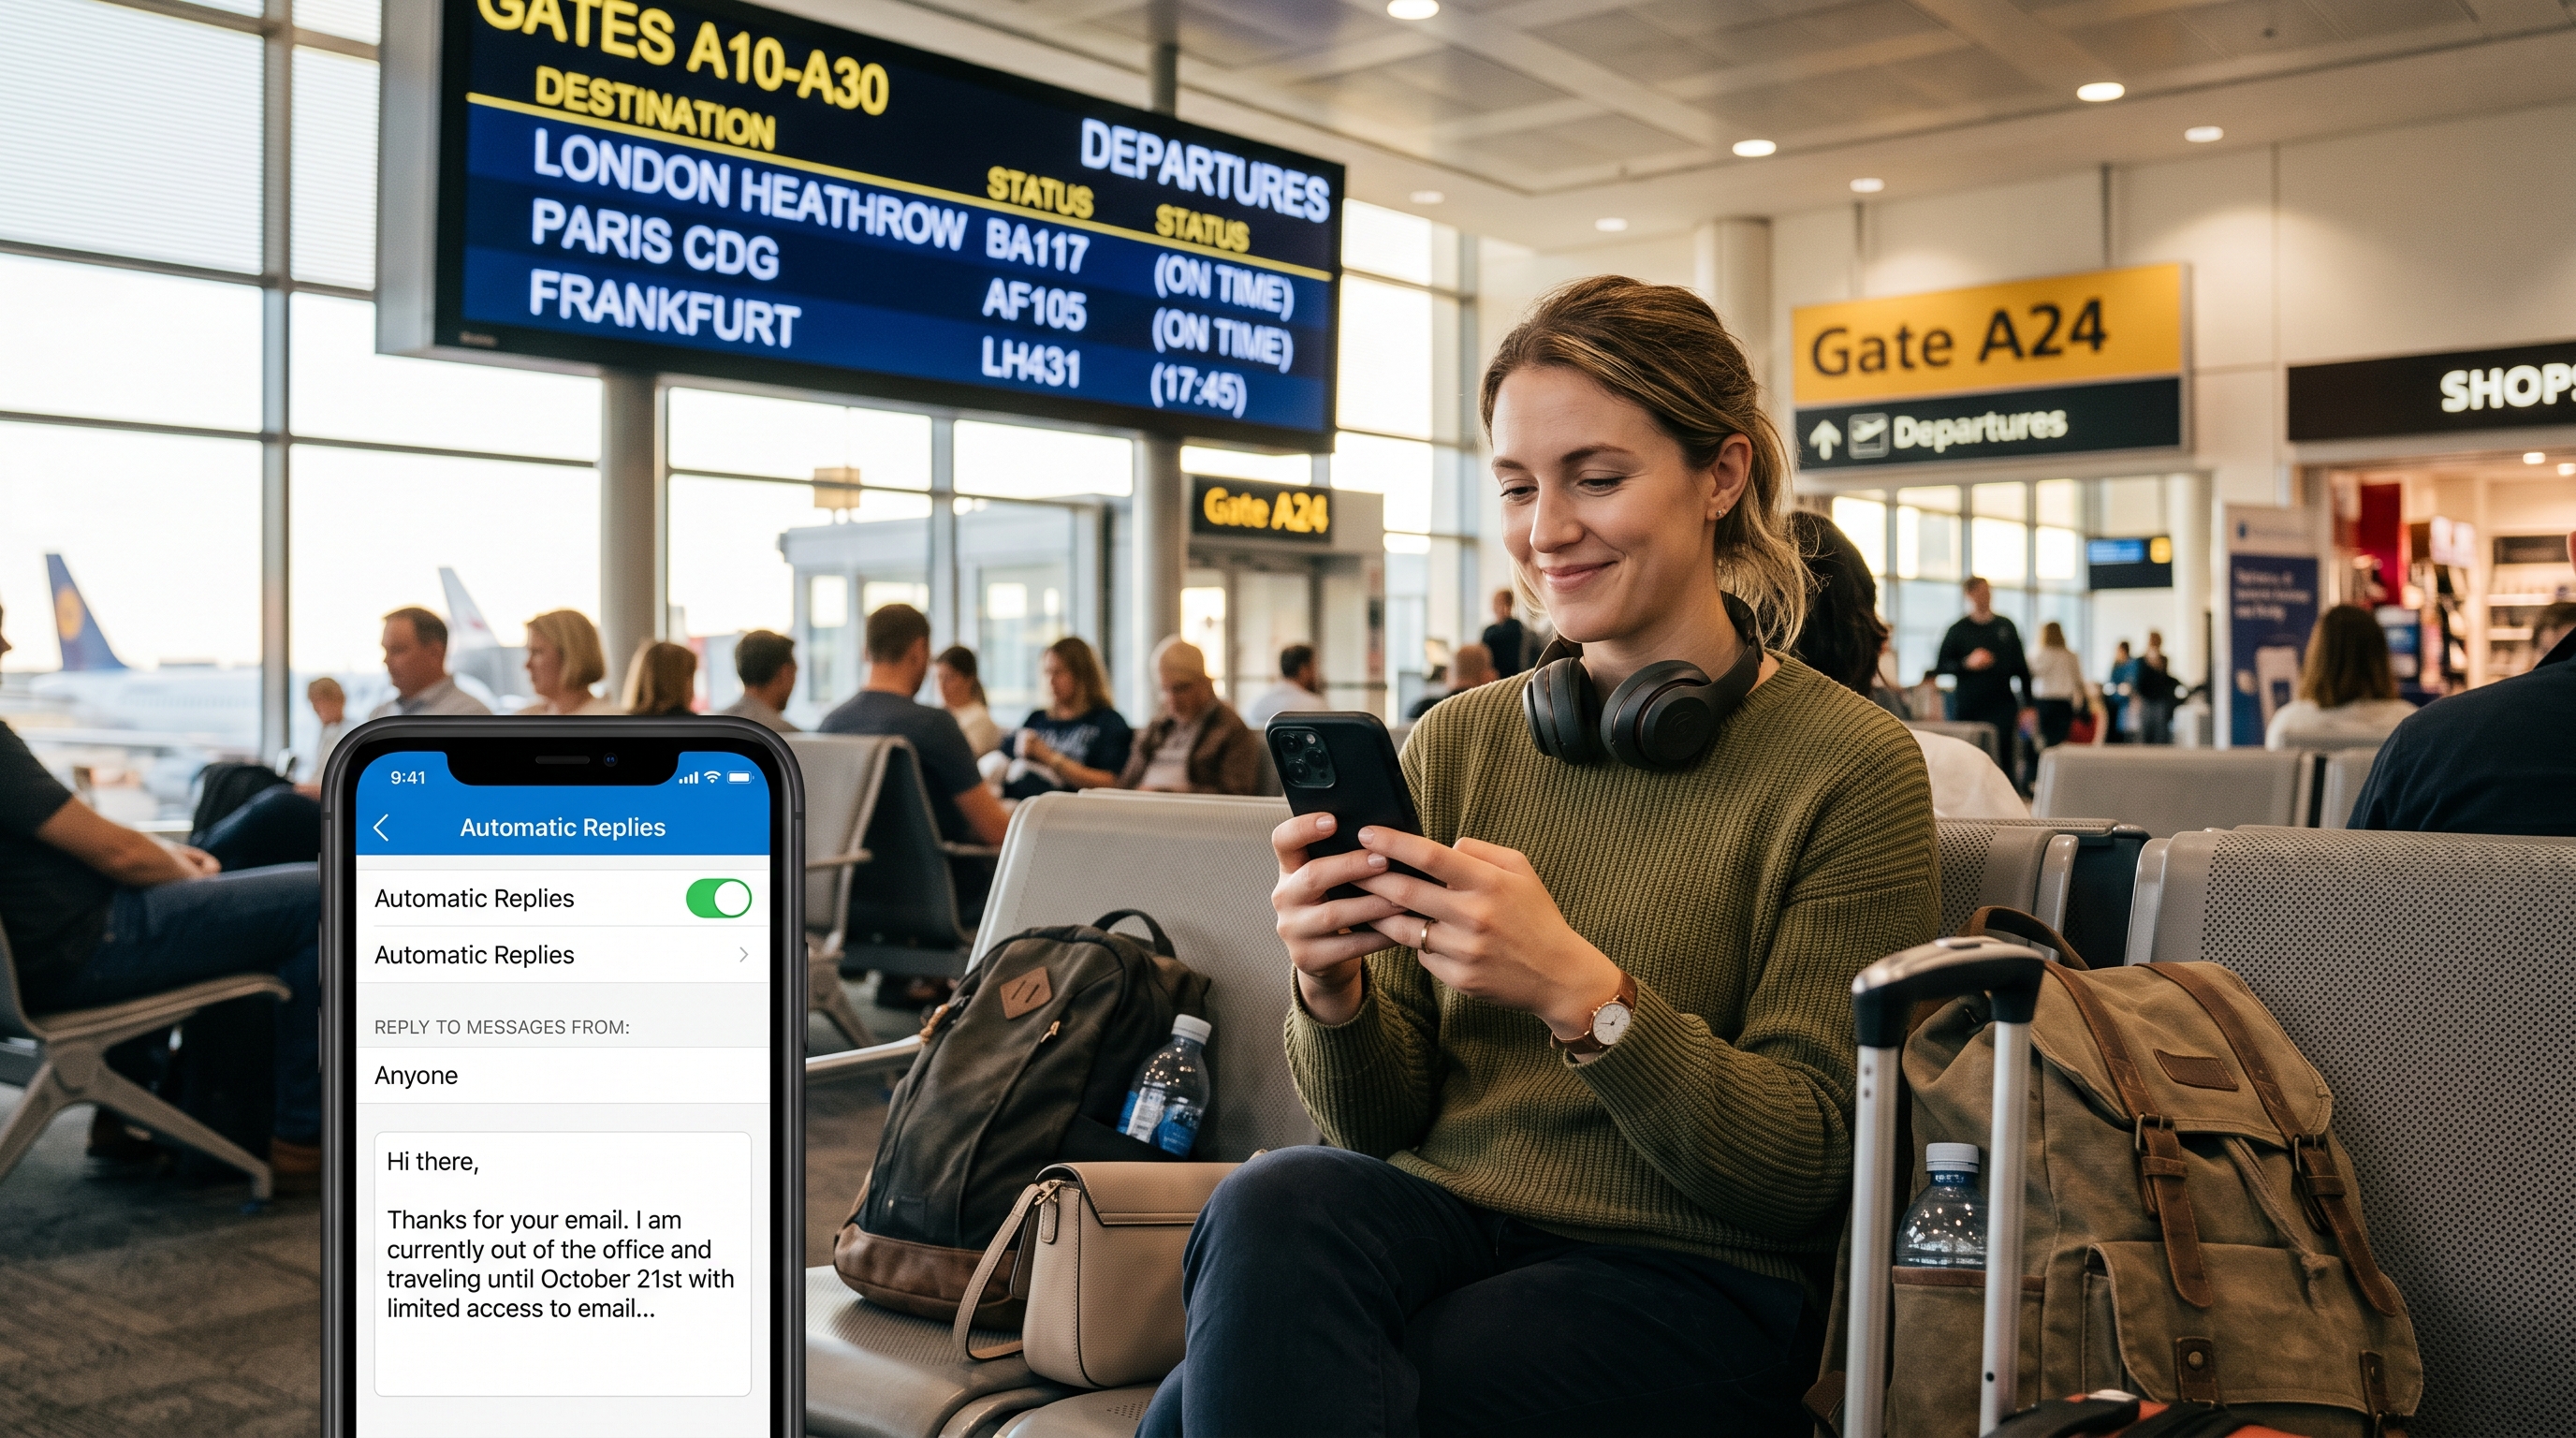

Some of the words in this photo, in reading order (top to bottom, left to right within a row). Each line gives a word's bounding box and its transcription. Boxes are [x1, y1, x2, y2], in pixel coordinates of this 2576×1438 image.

[686, 22, 889, 115] A10-A30
[535, 66, 776, 151] DESTINATION
[987, 166, 1095, 219] STATUS
[1154, 204, 1251, 254] STATUS
[1080, 118, 1330, 223] DEPARTURES
[534, 128, 730, 208] LONDON
[740, 168, 968, 251] HEATHROW
[986, 217, 1090, 273] BA117
[1153, 253, 1211, 299] (ON
[1214, 265, 1294, 322] TIME)
[532, 198, 672, 266] PARIS
[682, 225, 779, 281] CDG
[983, 277, 1087, 331] AF105
[1152, 306, 1210, 353] (ON
[1213, 317, 1293, 374] TIME)
[530, 269, 801, 349] FRANKFURT
[982, 335, 1080, 388] LH431
[1150, 362, 1247, 418] (17:45)
[1811, 323, 1954, 378] Gate
[1976, 297, 2107, 363] A24
[2440, 362, 2576, 413] SHOP
[1893, 408, 2068, 454] Departures
[1203, 486, 1270, 529] Gate
[1270, 491, 1329, 534] A24
[390, 770, 425, 785] 9:41
[460, 816, 578, 837] Automatic
[583, 816, 666, 842] Replies
[373, 888, 488, 908] Automatic
[494, 888, 575, 913] Replies
[373, 944, 488, 965] Automatic
[494, 944, 575, 969] Replies
[374, 1020, 431, 1034] REPLY
[435, 1019, 461, 1035] TO
[467, 1019, 566, 1035] MESSAGES
[572, 1019, 630, 1035] FROM:
[373, 1064, 459, 1090] Anyone
[388, 1151, 410, 1171] Hi
[415, 1151, 479, 1176] there,
[387, 1209, 467, 1230] Thanks
[472, 1209, 505, 1230] for
[509, 1213, 560, 1235] your
[564, 1209, 629, 1230] email.
[636, 1210, 642, 1230] I
[648, 1214, 681, 1230] am
[387, 1239, 485, 1264] currently
[490, 1240, 527, 1260] out
[533, 1239, 555, 1260] of
[560, 1239, 596, 1259] the
[602, 1239, 665, 1259] office
[670, 1239, 711, 1259] and
[387, 1268, 481, 1294] traveling
[488, 1268, 534, 1289] until
[541, 1268, 631, 1289] October
[637, 1269, 683, 1289] 21st
[688, 1268, 735, 1289] with
[388, 1297, 460, 1318] limited
[466, 1302, 544, 1318] access
[549, 1299, 572, 1318] to
[578, 1297, 655, 1318] email...
